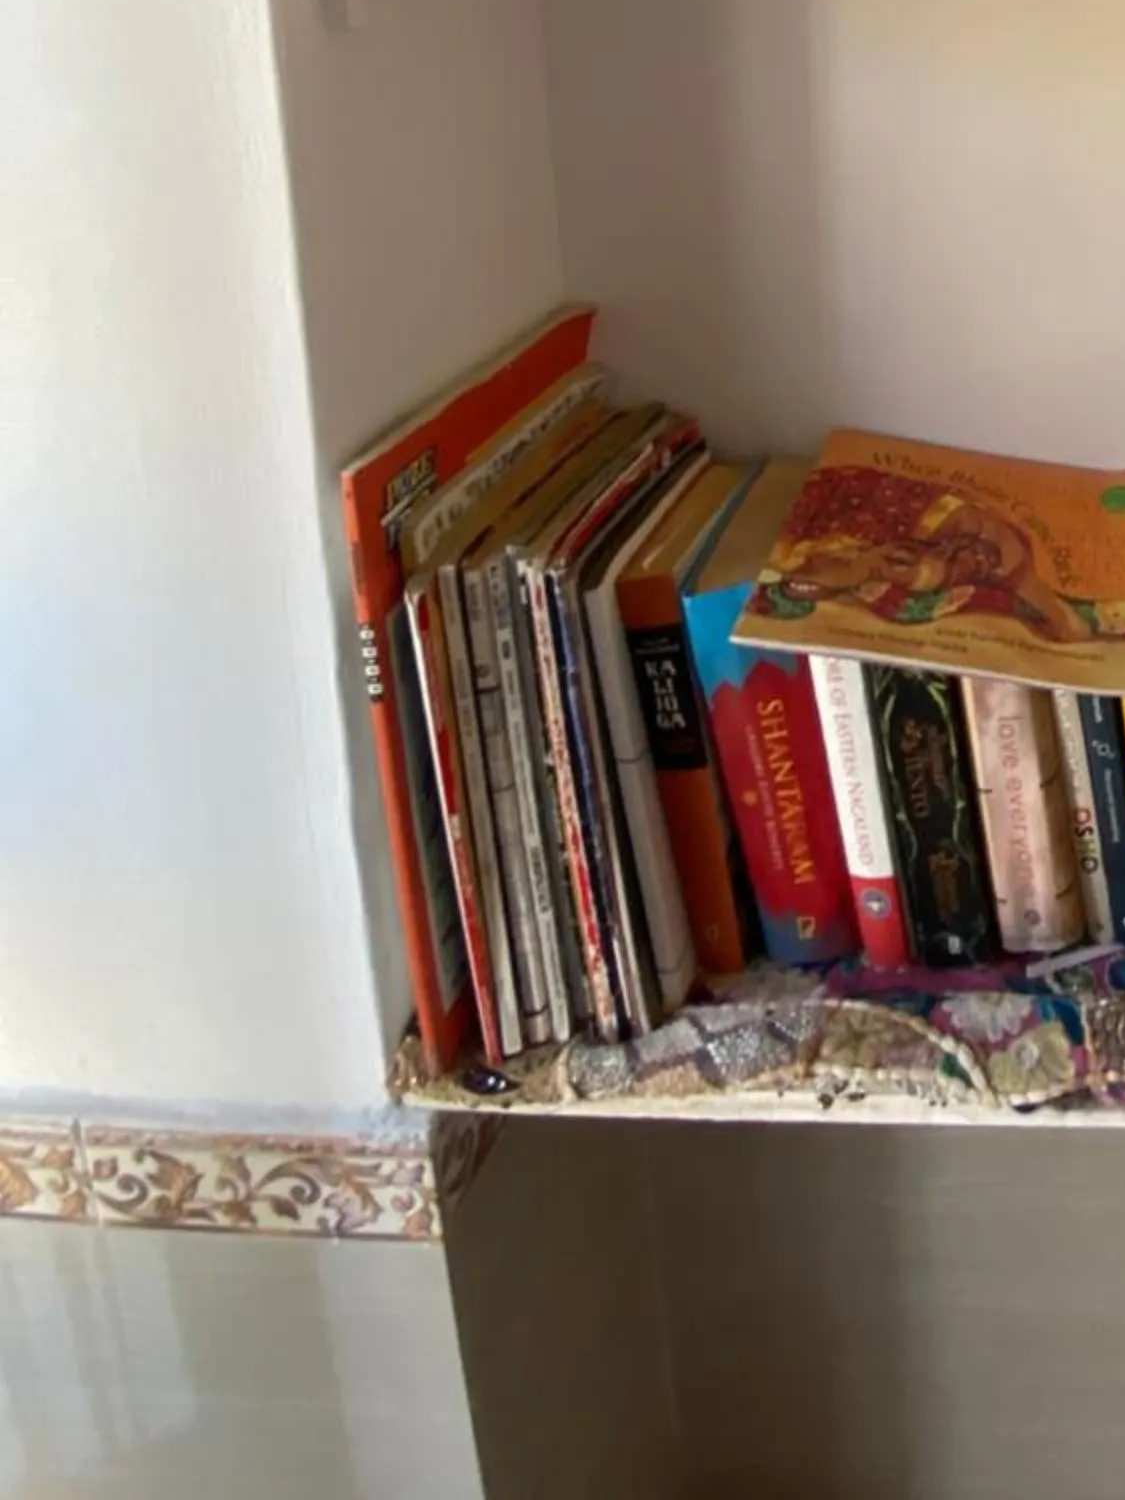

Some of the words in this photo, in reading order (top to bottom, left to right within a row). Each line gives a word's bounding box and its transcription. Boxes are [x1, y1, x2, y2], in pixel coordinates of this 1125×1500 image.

[998, 716, 1023, 769] love
[757, 698, 816, 886] SHANTARAM
[1074, 807, 1099, 874] OSHO
